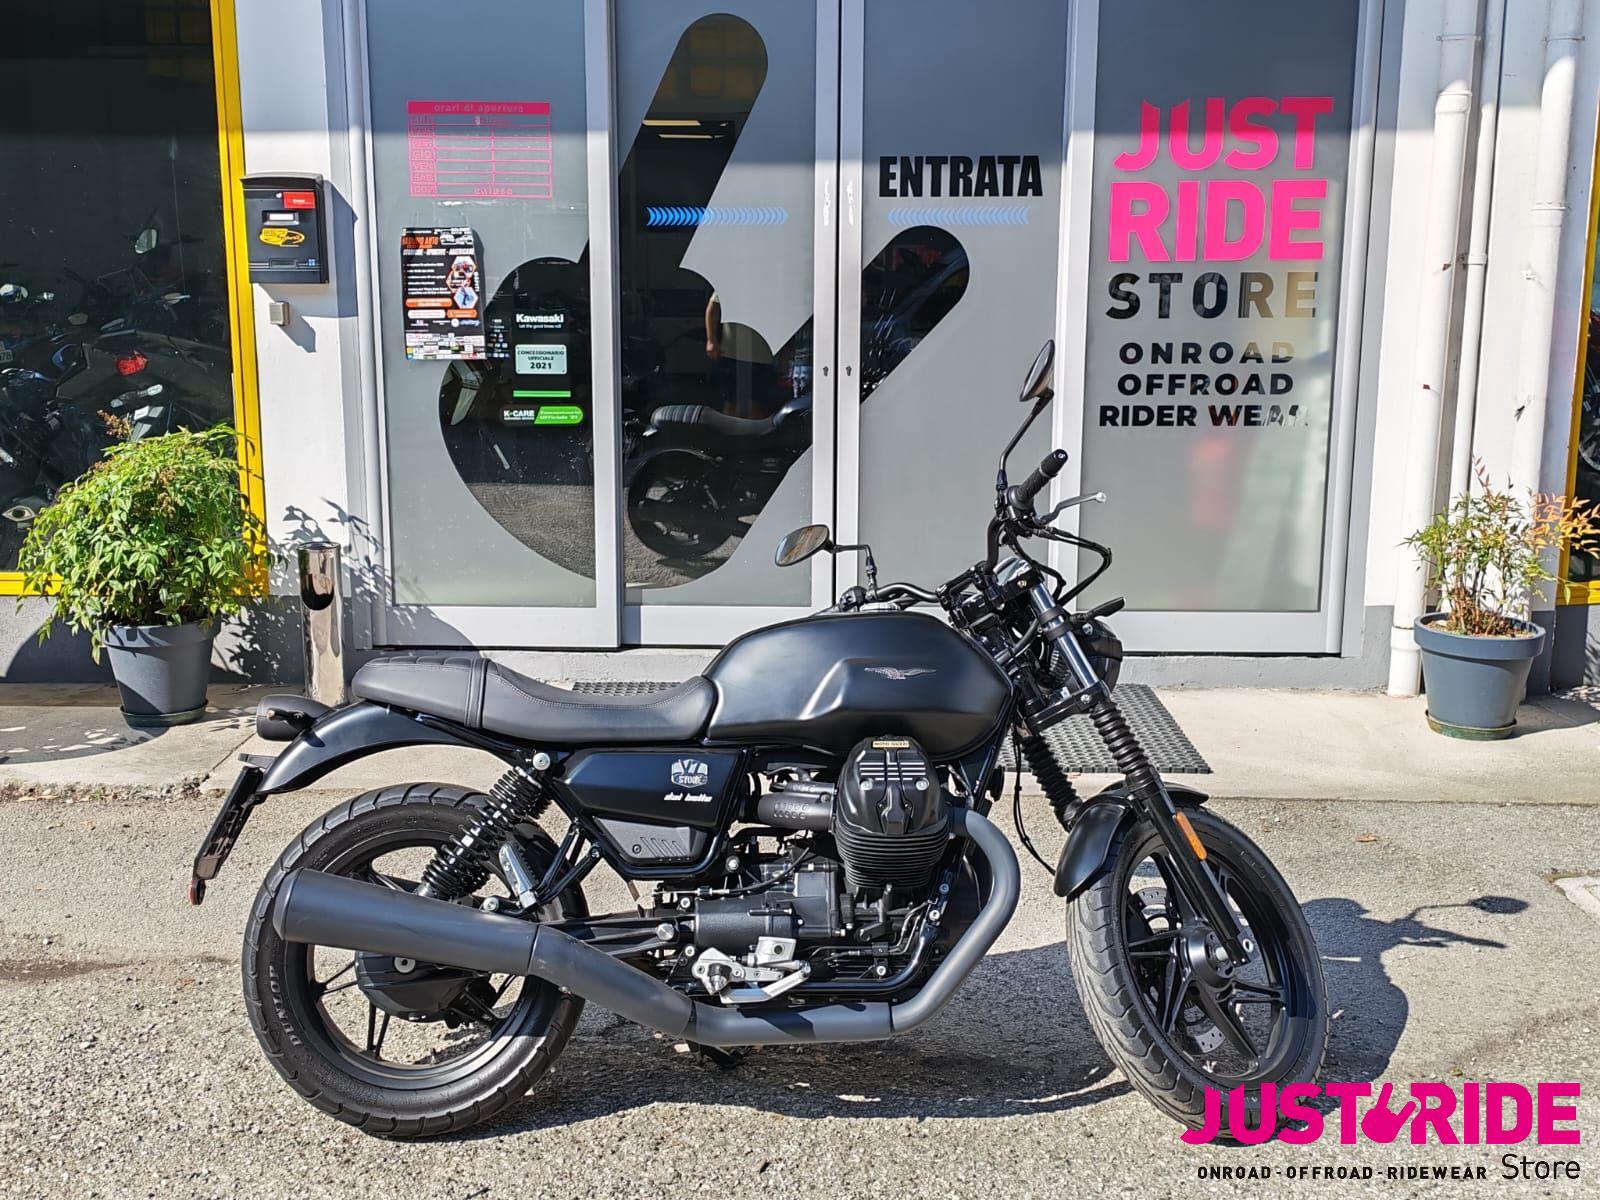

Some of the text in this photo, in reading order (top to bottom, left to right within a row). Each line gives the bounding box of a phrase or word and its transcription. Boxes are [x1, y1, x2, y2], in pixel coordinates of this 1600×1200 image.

[434, 103, 524, 114] orari di apertura
[1113, 97, 1334, 171] JUST
[878, 155, 1043, 197] ENTRATA
[1108, 179, 1328, 262] RIDE
[1105, 272, 1319, 319] STORE
[515, 314, 564, 323] Kawasaki
[1119, 342, 1296, 364] ONROAD
[530, 362, 552, 370] 2021
[1117, 374, 1294, 396] OFFROAD
[1099, 405, 1198, 427] RIDER
